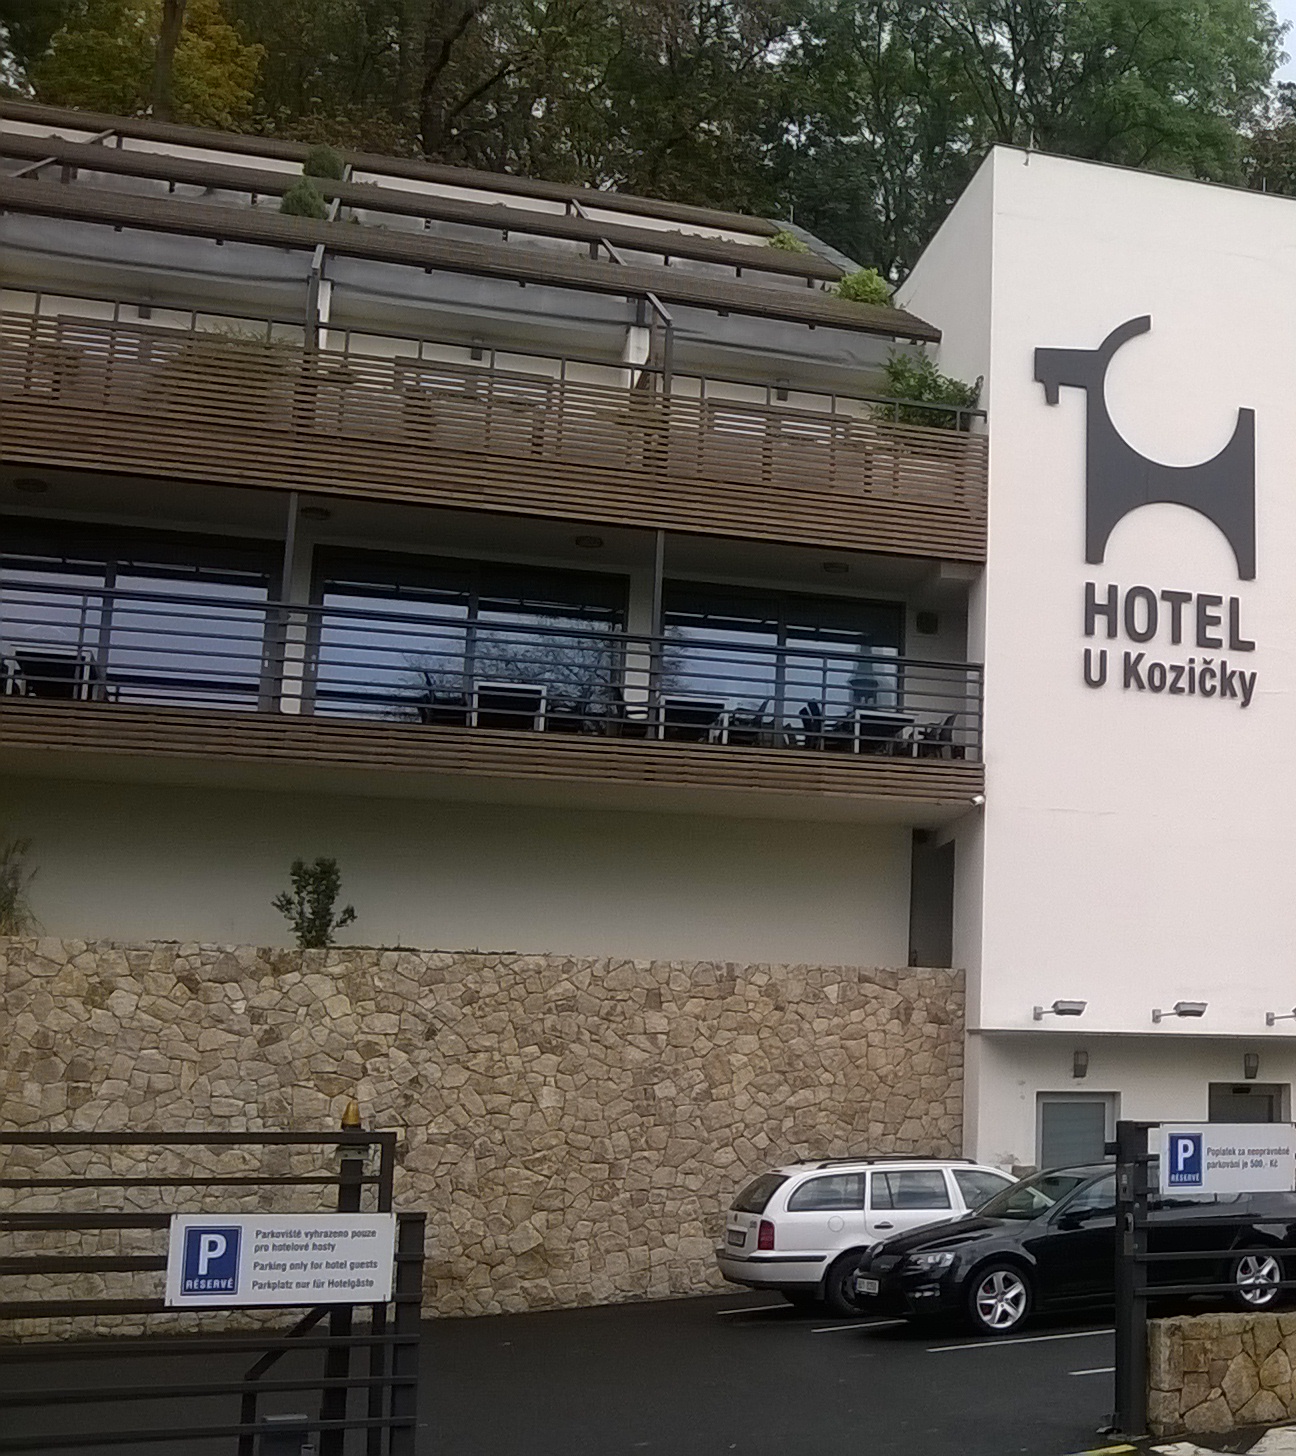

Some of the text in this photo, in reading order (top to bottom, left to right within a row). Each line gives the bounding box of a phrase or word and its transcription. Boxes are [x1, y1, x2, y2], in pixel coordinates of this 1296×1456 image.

[1085, 582, 1256, 652] HOTEL
[1084, 648, 1257, 708] U Kozičky
[1177, 1139, 1195, 1171] P
[1206, 1146, 1236, 1157] Poplatek
[1241, 1159, 1248, 1170] je
[1269, 1159, 1278, 1168] Kč
[255, 1229, 377, 1240] Parkoviště vyhrazeno pouze
[198, 1233, 227, 1275] P
[254, 1242, 336, 1254] pro hotelové hosty
[253, 1260, 378, 1272] Parking only for hotel guests
[185, 1277, 234, 1290] RÉSERVÉ
[252, 1278, 374, 1291] Parkplatz nur für Hotelgäste
